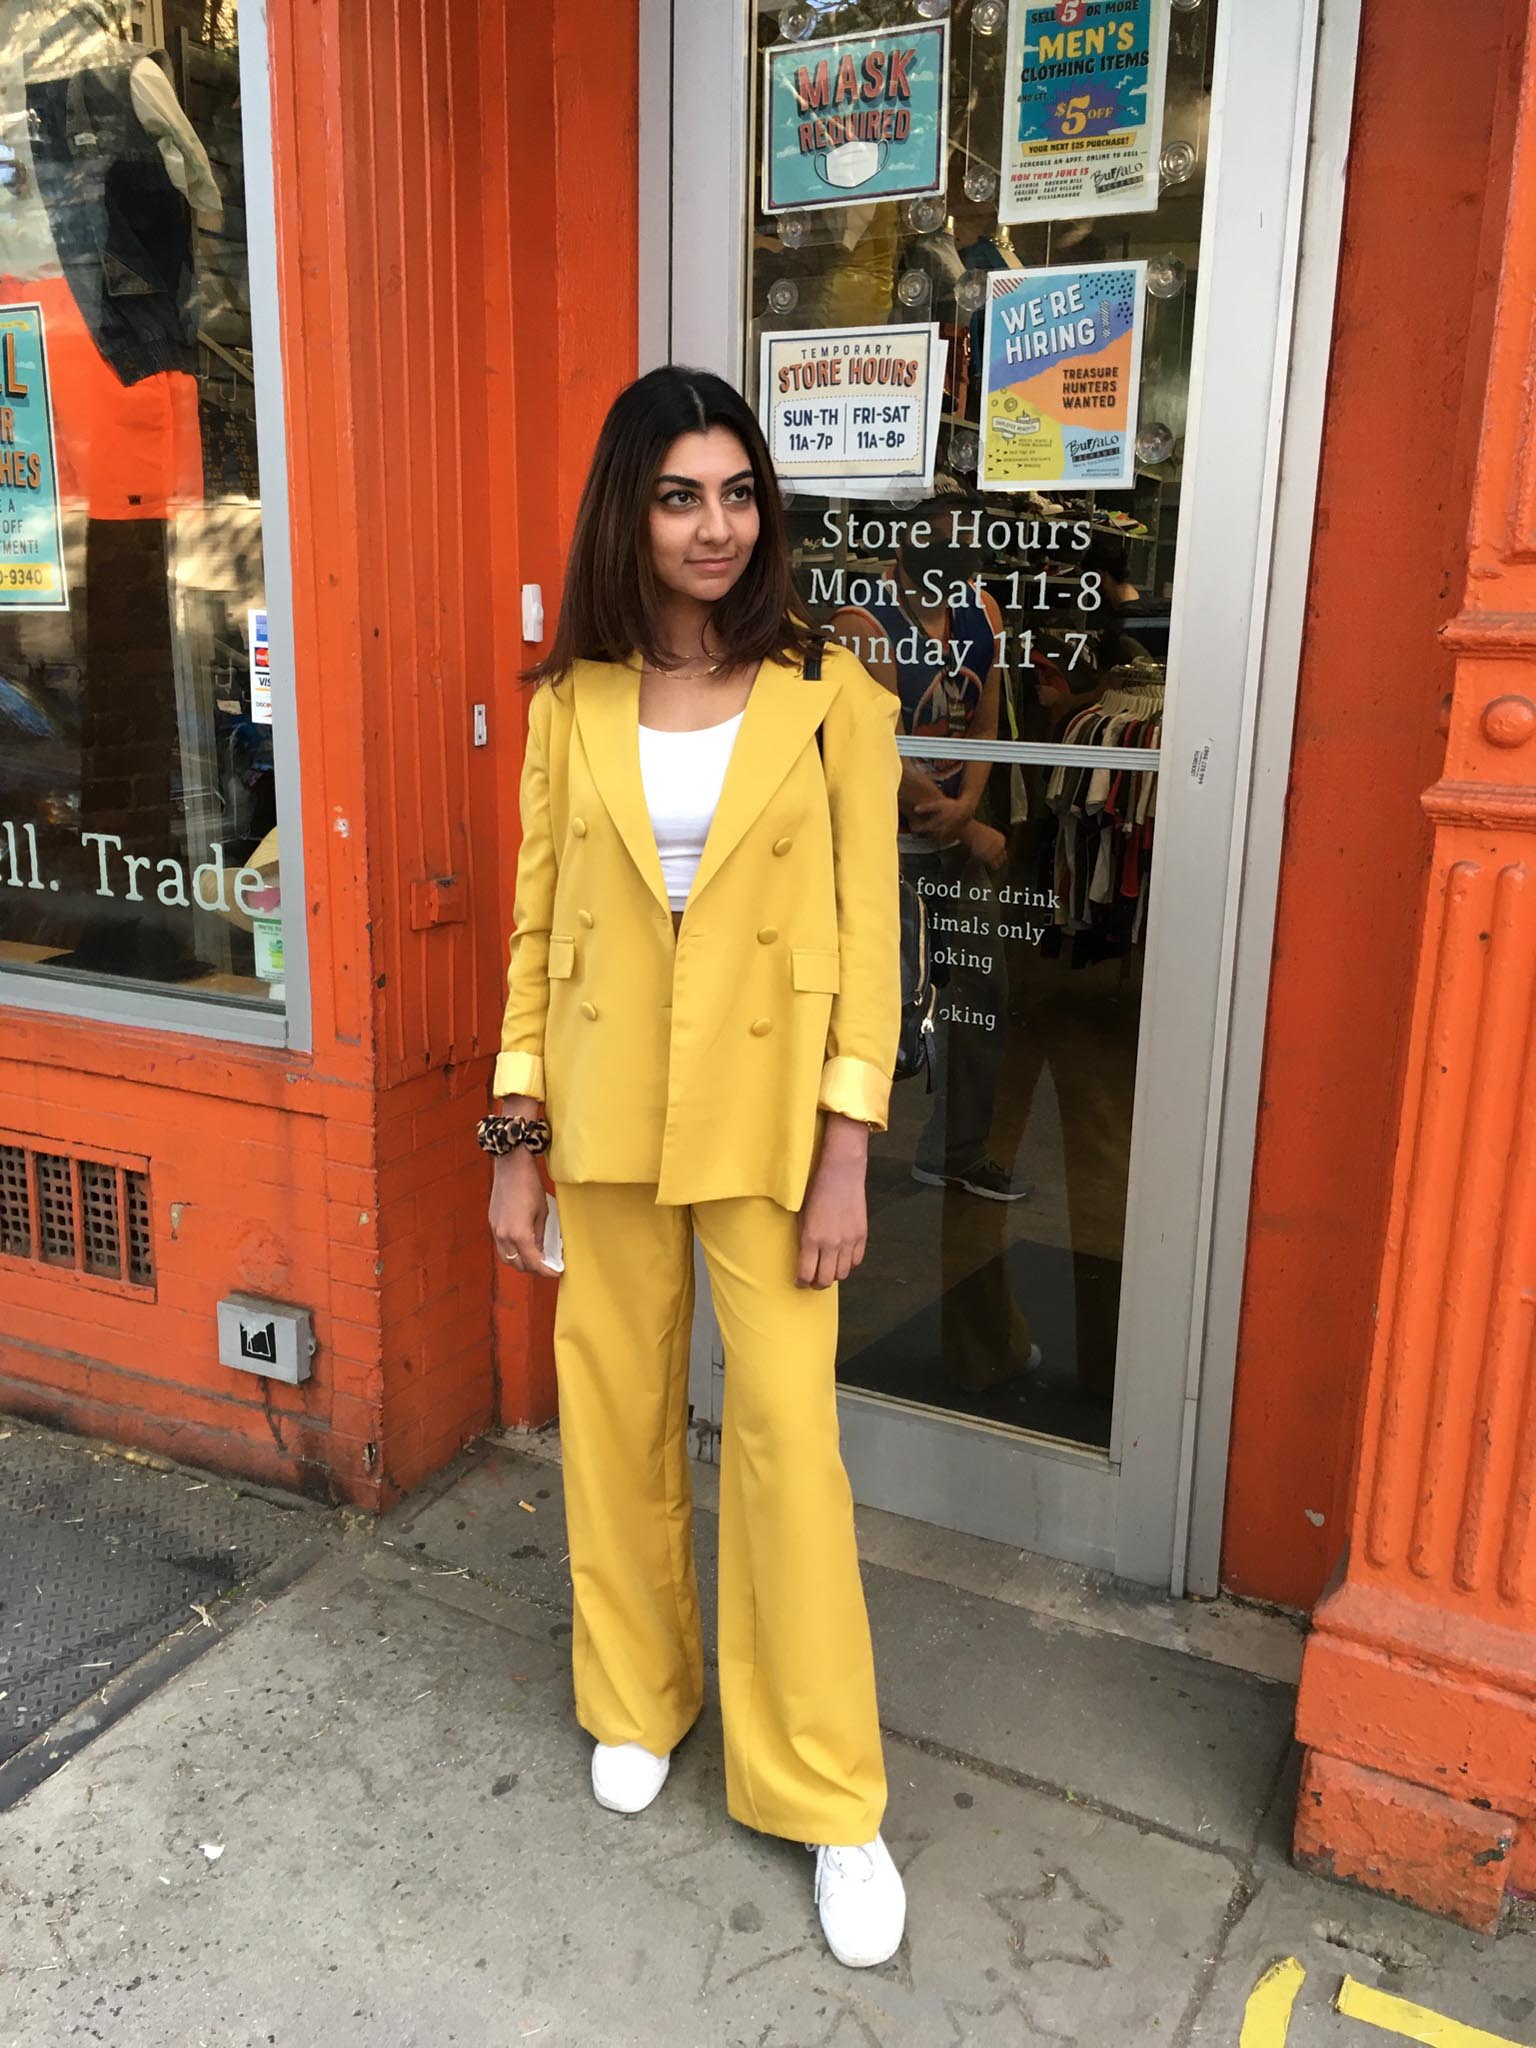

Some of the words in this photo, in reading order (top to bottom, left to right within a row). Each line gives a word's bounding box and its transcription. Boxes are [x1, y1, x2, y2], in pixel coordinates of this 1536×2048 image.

[1031, 11, 1057, 24] SELL
[1060, 0, 1080, 22] 5
[1086, 4, 1101, 16] OR
[1105, 1, 1140, 14] MORE
[1038, 21, 1135, 64] MEN'S
[1020, 57, 1095, 83] CLOTHING
[1100, 51, 1149, 71] ITEMS
[794, 48, 917, 113] MASK
[1087, 106, 1114, 119] OFF
[798, 109, 911, 153] REQUIRED
[1028, 144, 1049, 154] YOUR
[1050, 141, 1069, 151] NEXT
[1071, 140, 1085, 150] $25
[1086, 136, 1129, 148] PURCHASE!
[1055, 169, 1078, 178] JUNE
[1080, 167, 1090, 176] 15
[1000, 283, 1085, 335] WE'RE
[802, 345, 892, 359] TEMPORARY
[1006, 318, 1096, 365] HIRING
[779, 358, 842, 393] STORE
[849, 357, 919, 388] HOURS
[1062, 367, 1119, 379] TREASURE
[1062, 381, 1117, 393] HUNTERS
[1062, 395, 1116, 409] WANTED
[783, 408, 839, 427] SUN-TH
[853, 405, 911, 425] FRI-SAT
[790, 433, 834, 451] 11A-7P
[857, 430, 906, 449] 11A-8P
[2, 519, 23, 534] OFF
[822, 510, 932, 549] Store
[949, 510, 1091, 550] Hours
[807, 568, 987, 609] Mon-Sat
[1005, 571, 1101, 611] 11-8
[992, 629, 1087, 671] 11-7
[82, 832, 264, 917] Trade
[917, 877, 961, 898] food
[969, 887, 992, 901] or
[999, 886, 1060, 909] drink
[997, 922, 1045, 946] only
